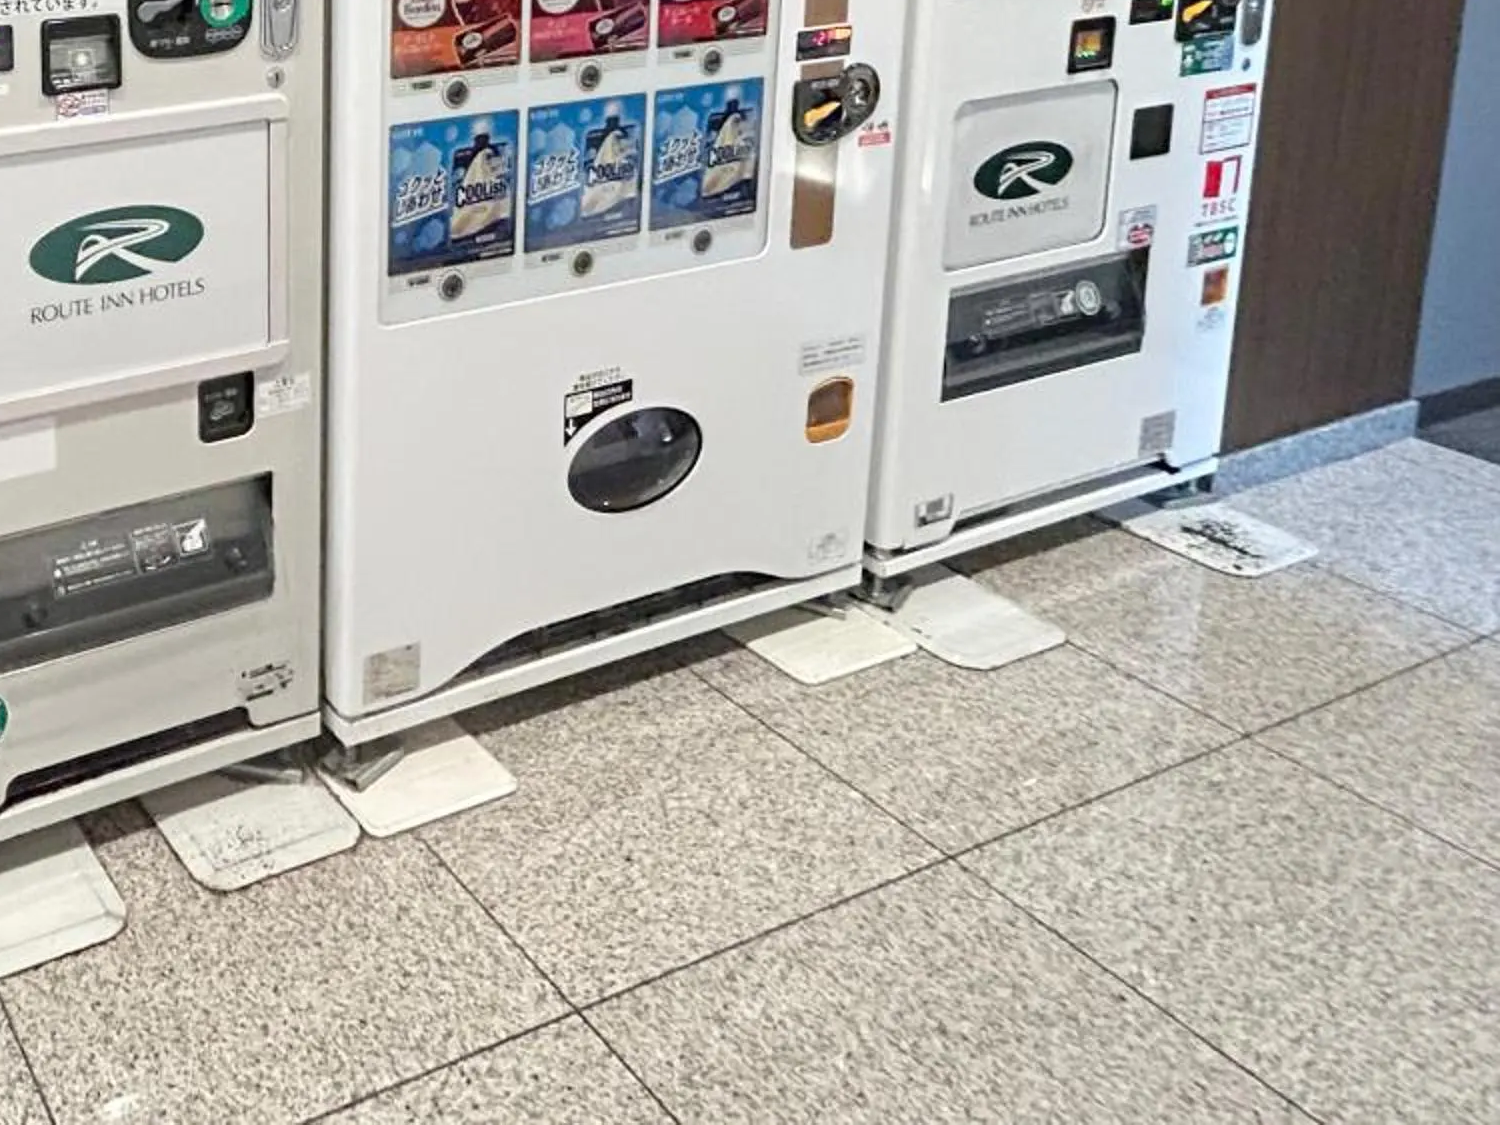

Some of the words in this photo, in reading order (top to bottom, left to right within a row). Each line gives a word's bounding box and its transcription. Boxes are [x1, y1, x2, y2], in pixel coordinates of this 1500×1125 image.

[30, 300, 93, 325] ROUTE
[100, 291, 135, 312] INN
[138, 277, 206, 307] HOTELS
